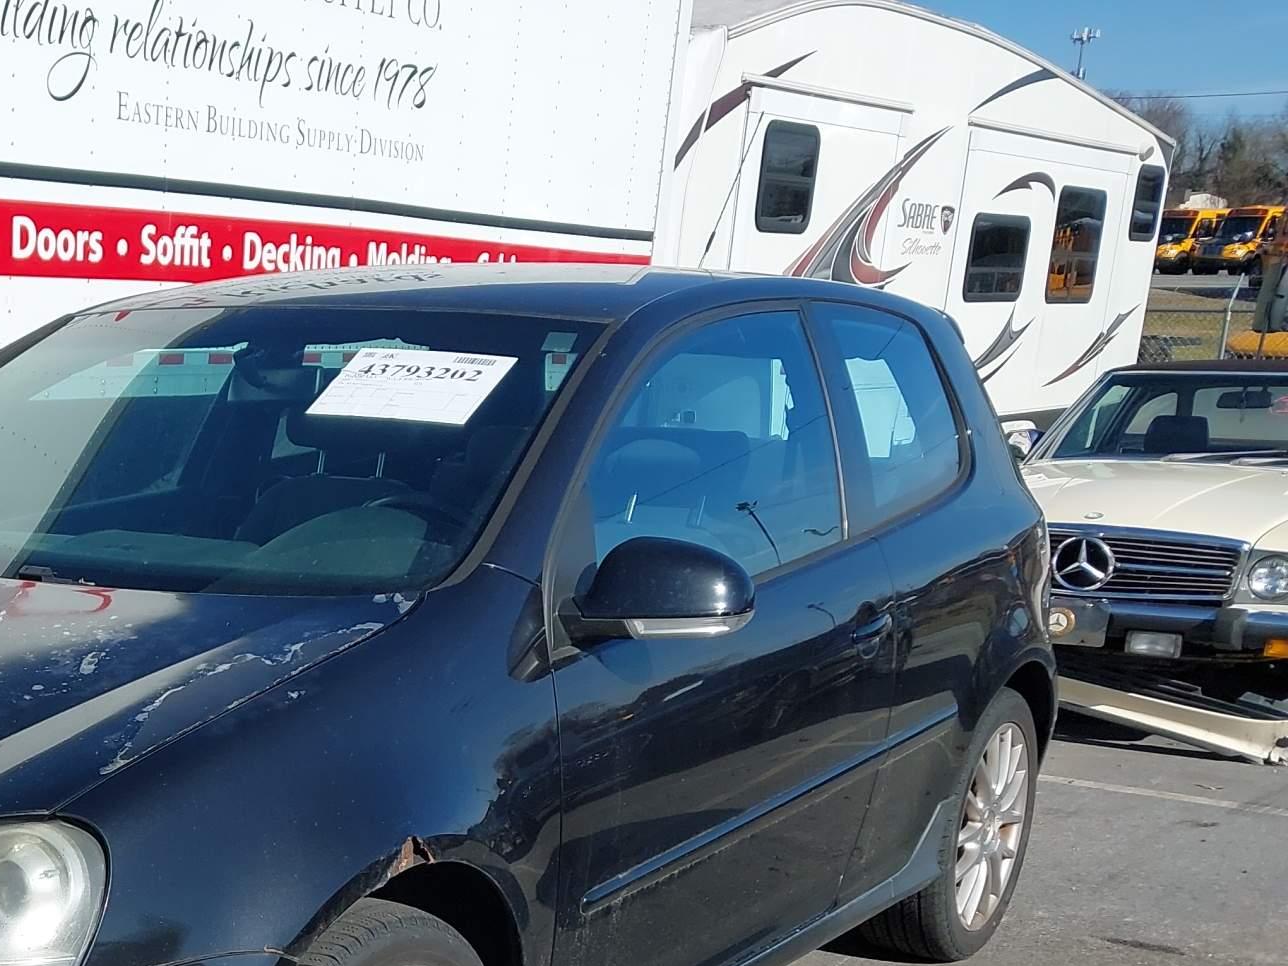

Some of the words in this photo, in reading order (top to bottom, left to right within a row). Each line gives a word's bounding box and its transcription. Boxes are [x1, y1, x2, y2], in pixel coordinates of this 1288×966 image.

[110, 0, 296, 108] relationships
[304, 44, 366, 98] since
[374, 57, 438, 109] 1978
[116, 91, 199, 131] EASTERN
[206, 105, 290, 144] BUILDING
[296, 118, 354, 153] SUPPLY
[360, 128, 425, 162] DIVISION
[897, 198, 940, 230] SABRE
[11, 215, 103, 264] Doors
[139, 223, 212, 268] Soffit
[358, 362, 484, 382] 43793202
